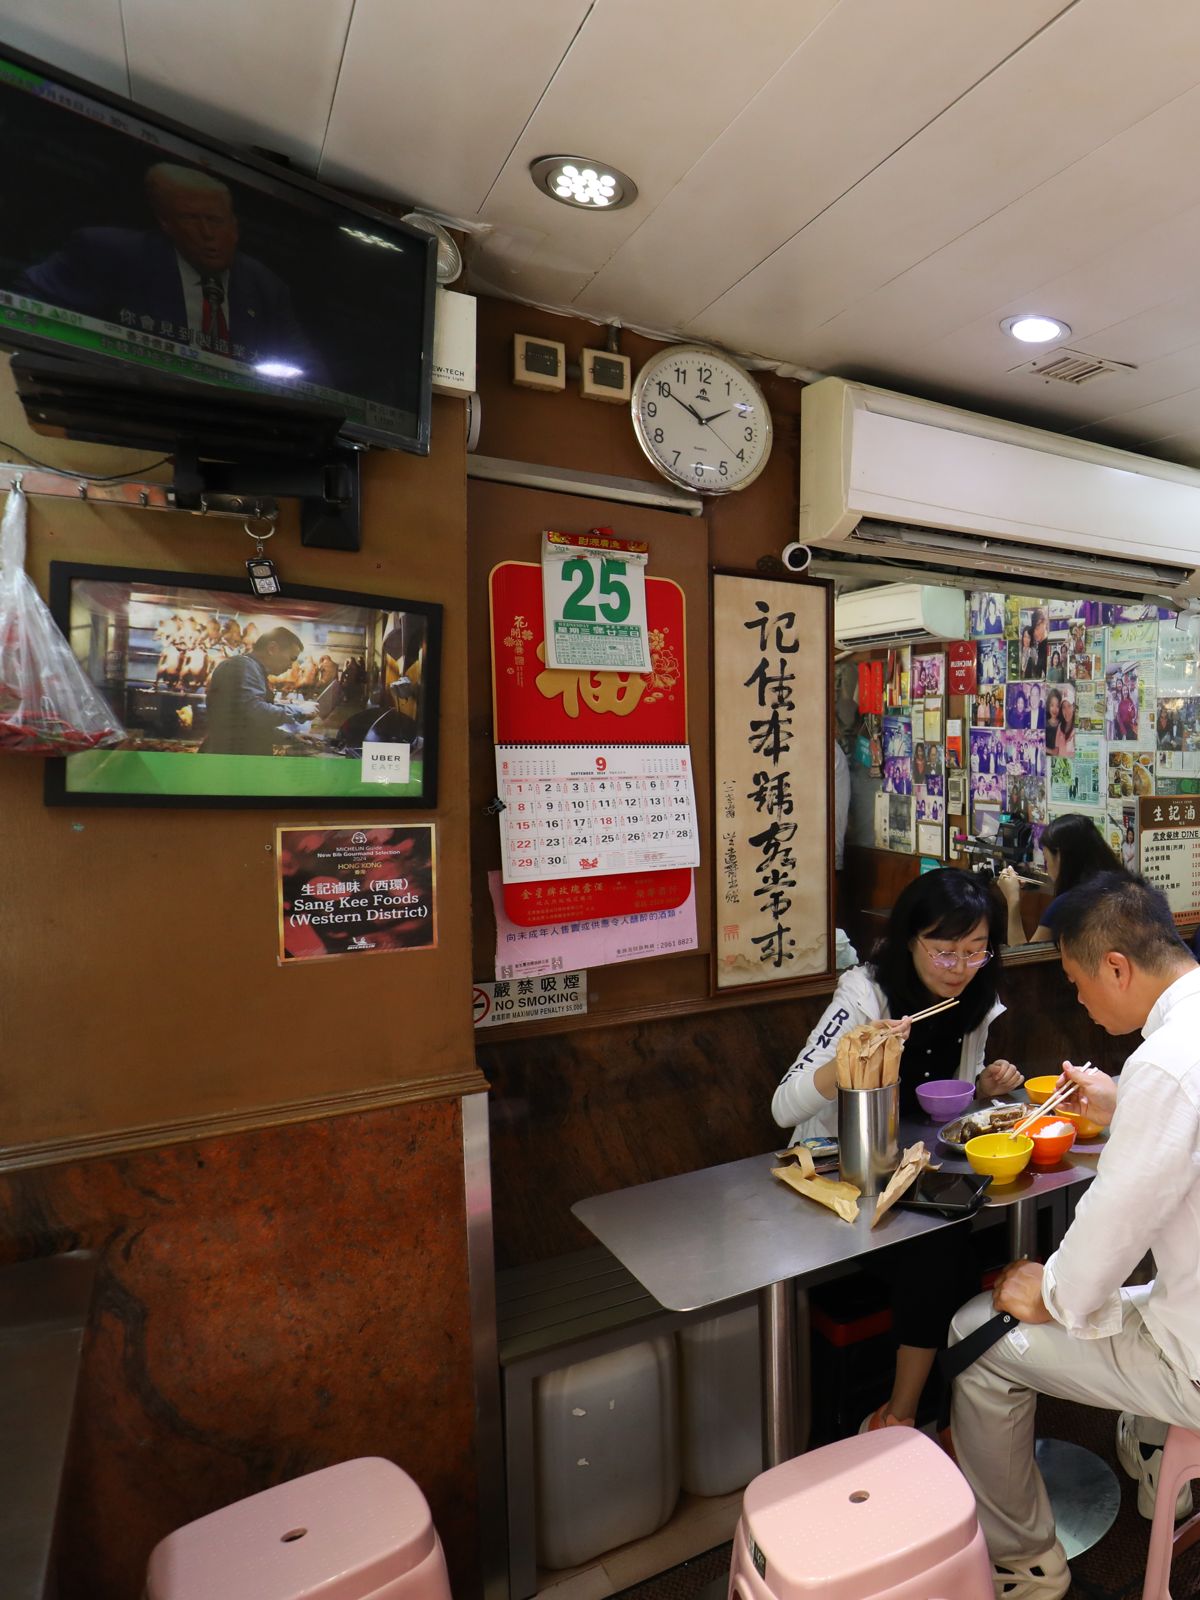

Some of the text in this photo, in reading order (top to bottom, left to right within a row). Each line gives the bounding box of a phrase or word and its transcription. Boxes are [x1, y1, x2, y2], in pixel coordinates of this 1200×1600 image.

[674, 368, 686, 384] 11
[697, 367, 712, 384] 12
[656, 381, 670, 397] 10
[725, 382, 730, 396] 1
[648, 402, 657, 417] 9
[654, 428, 664, 443] 8
[744, 427, 752, 441] 3
[672, 450, 681, 465] 7
[736, 449, 744, 461] 4
[695, 462, 703, 476] 6
[719, 461, 728, 475] 5
[562, 558, 631, 623] 25
[595, 757, 606, 771] 9
[545, 784, 551, 792] 2
[546, 820, 558, 828] 16
[519, 859, 532, 867] 29
[294, 893, 418, 912] Sang Kee Foods
[290, 906, 428, 927] (Western District)
[494, 975, 580, 998] 嚴禁吸煙
[495, 992, 579, 1011] NO SMOKING
[512, 1009, 539, 1019] MAXIMUM
[540, 1006, 564, 1016] PENALTY
[566, 1004, 583, 1013] $5,000
[815, 1008, 850, 1049] RUN
